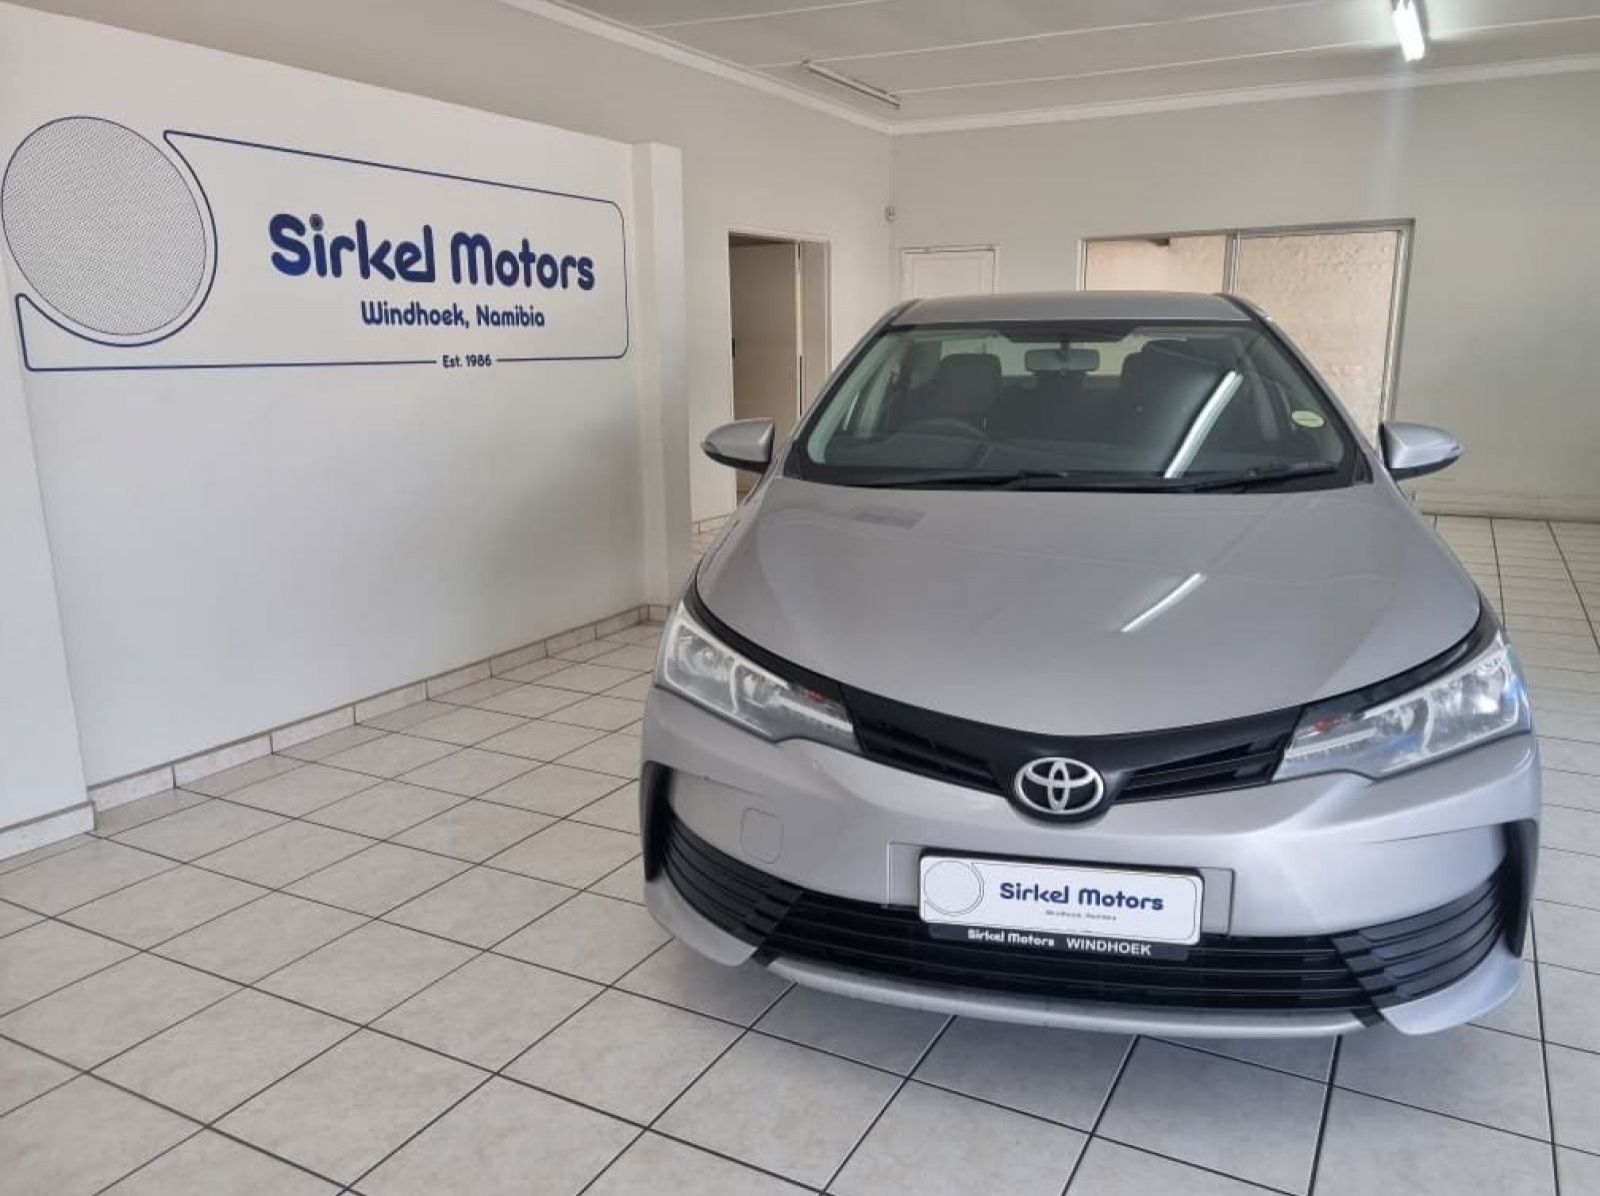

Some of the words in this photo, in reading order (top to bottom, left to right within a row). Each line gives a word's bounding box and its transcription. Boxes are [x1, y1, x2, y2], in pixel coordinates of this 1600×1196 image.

[269, 213, 434, 283] Sirkel
[451, 232, 595, 291] Motors
[361, 300, 471, 329] Windhoek,
[476, 304, 545, 329] Namibia
[442, 353, 463, 369] Est.
[465, 352, 492, 368] 1986
[1000, 882, 1069, 904] Sirkel
[1079, 888, 1164, 910] Motors
[967, 928, 1005, 942] Sirkel
[1007, 932, 1055, 947] Motors
[1066, 937, 1152, 955] WINDHOEK
